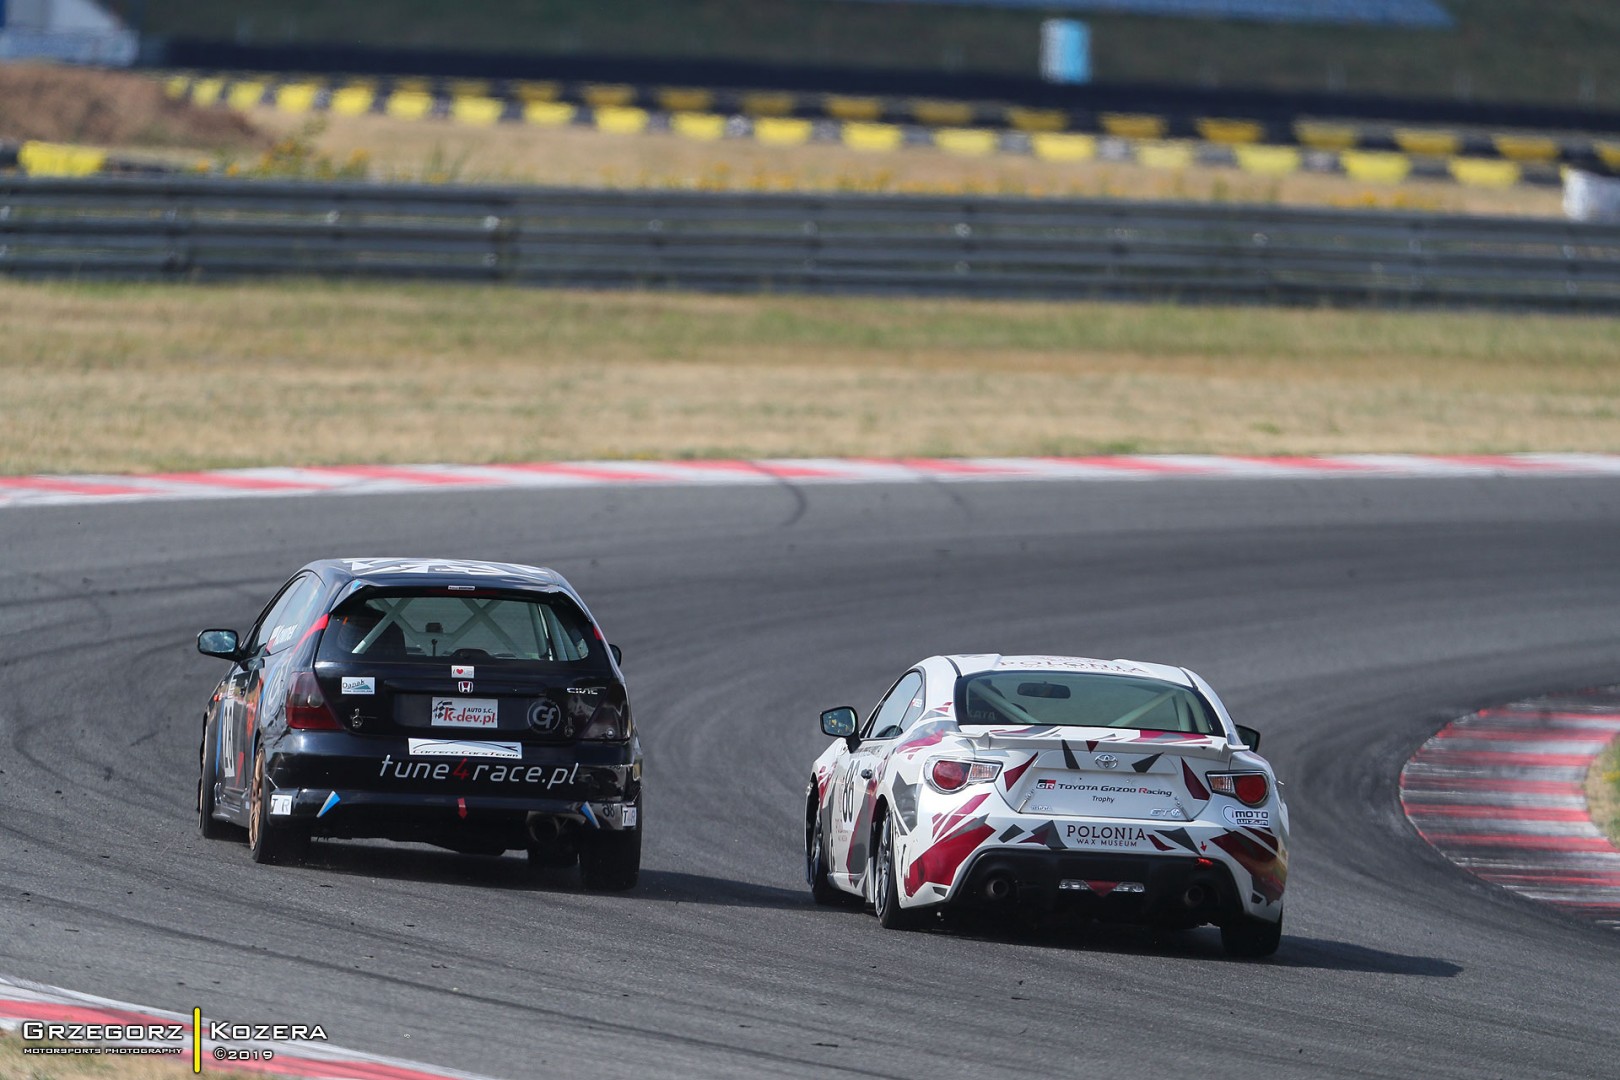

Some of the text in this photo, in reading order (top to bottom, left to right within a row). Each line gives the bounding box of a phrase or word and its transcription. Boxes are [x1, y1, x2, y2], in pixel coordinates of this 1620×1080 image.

[379, 754, 579, 790] tune4race.pl
[1036, 780, 1172, 798] GR TOYOTA GAZOO Racing
[1092, 795, 1115, 804] Trophy
[1066, 824, 1147, 841] POLONIA
[1100, 839, 1137, 847] MUSEUM
